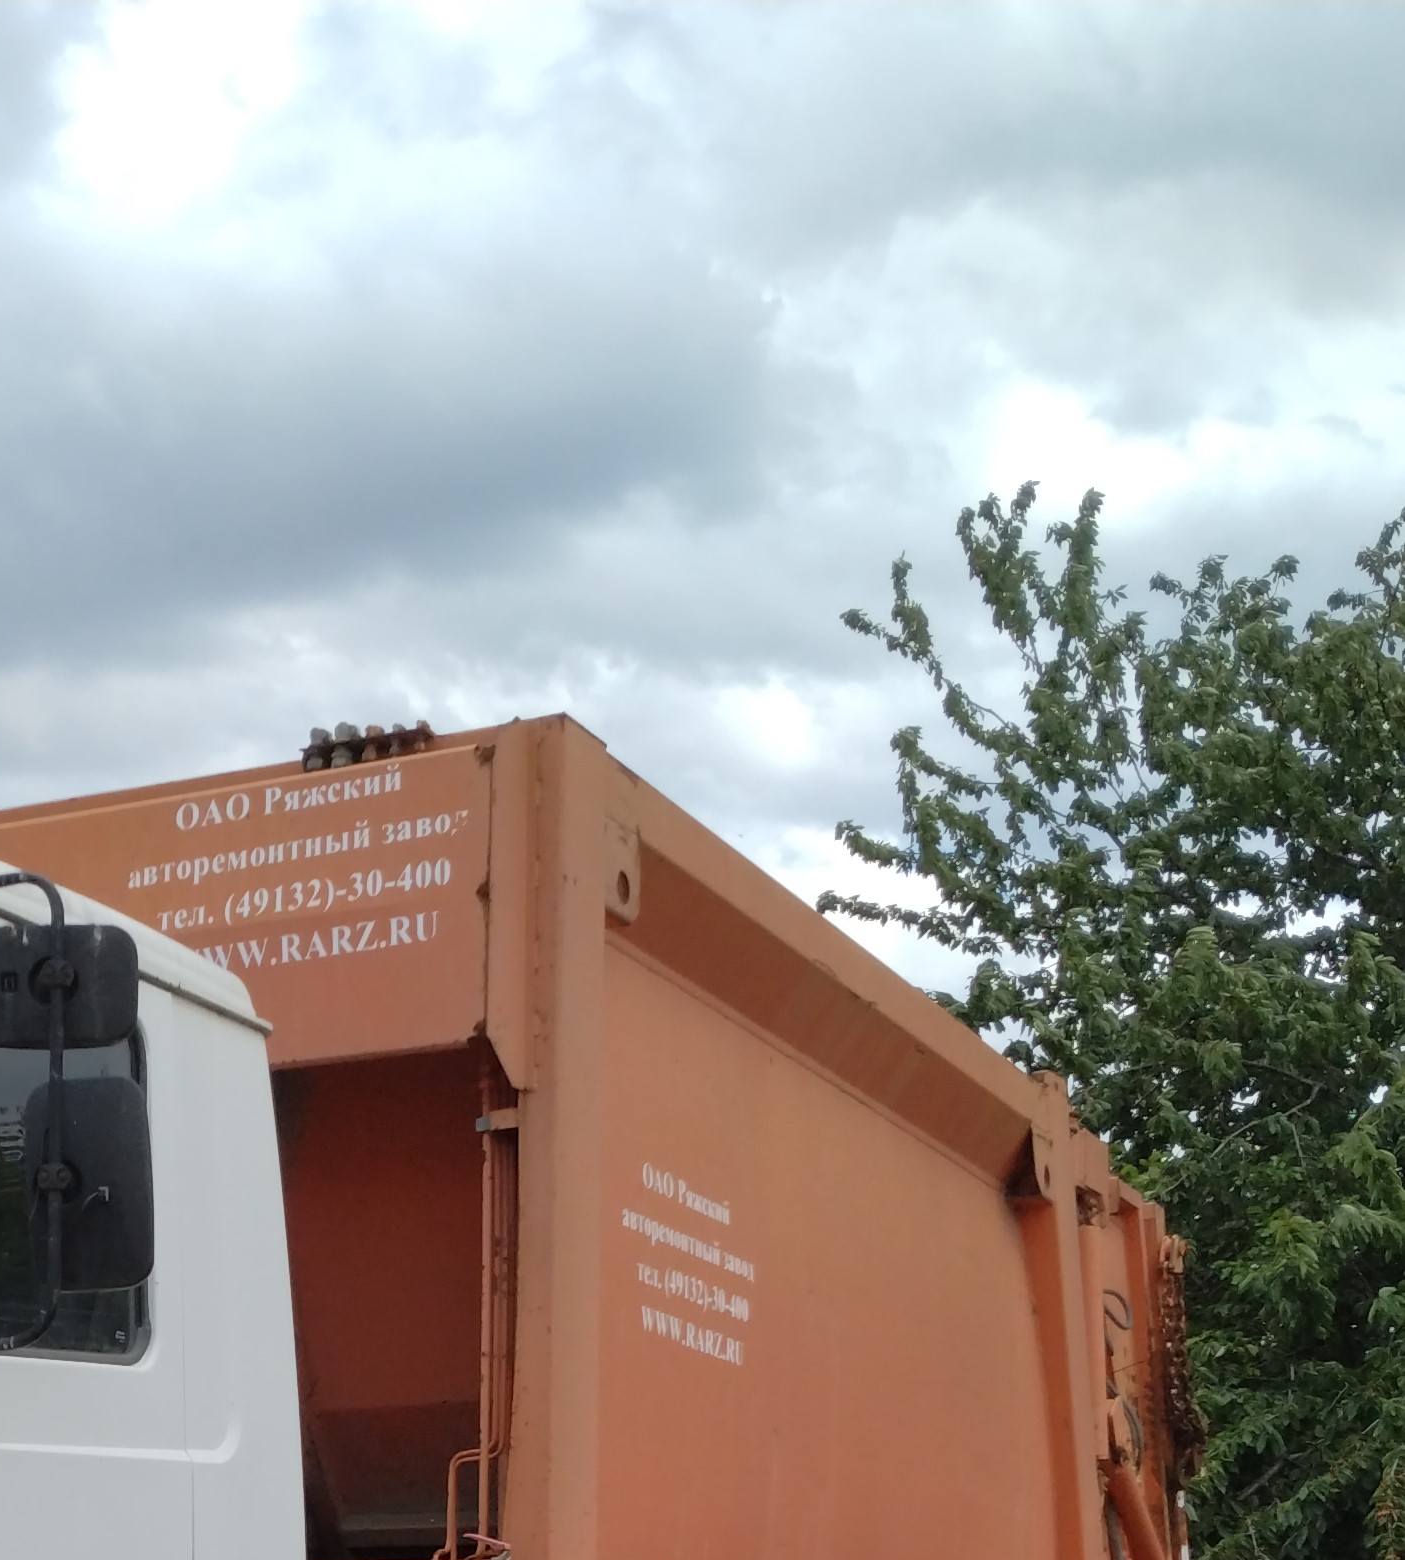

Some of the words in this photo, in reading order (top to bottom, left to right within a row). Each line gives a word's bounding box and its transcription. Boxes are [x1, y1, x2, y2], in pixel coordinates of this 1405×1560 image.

[176, 792, 250, 831] ОАО
[264, 764, 402, 815] Ряжский
[128, 821, 370, 889] авторемонтный
[157, 906, 215, 932] тел.
[224, 857, 452, 926] (49132)-30-400
[196, 910, 440, 970] WW.RARZ.RU
[642, 1162, 674, 1199] ОАО
[678, 1179, 730, 1226] Ряжский
[622, 1208, 721, 1266] авторемонтный
[723, 1251, 755, 1283] завод
[636, 1262, 663, 1290] тел.
[664, 1266, 750, 1323] (49132)-30-400
[641, 1305, 745, 1366] WWW.RARZ.RU
